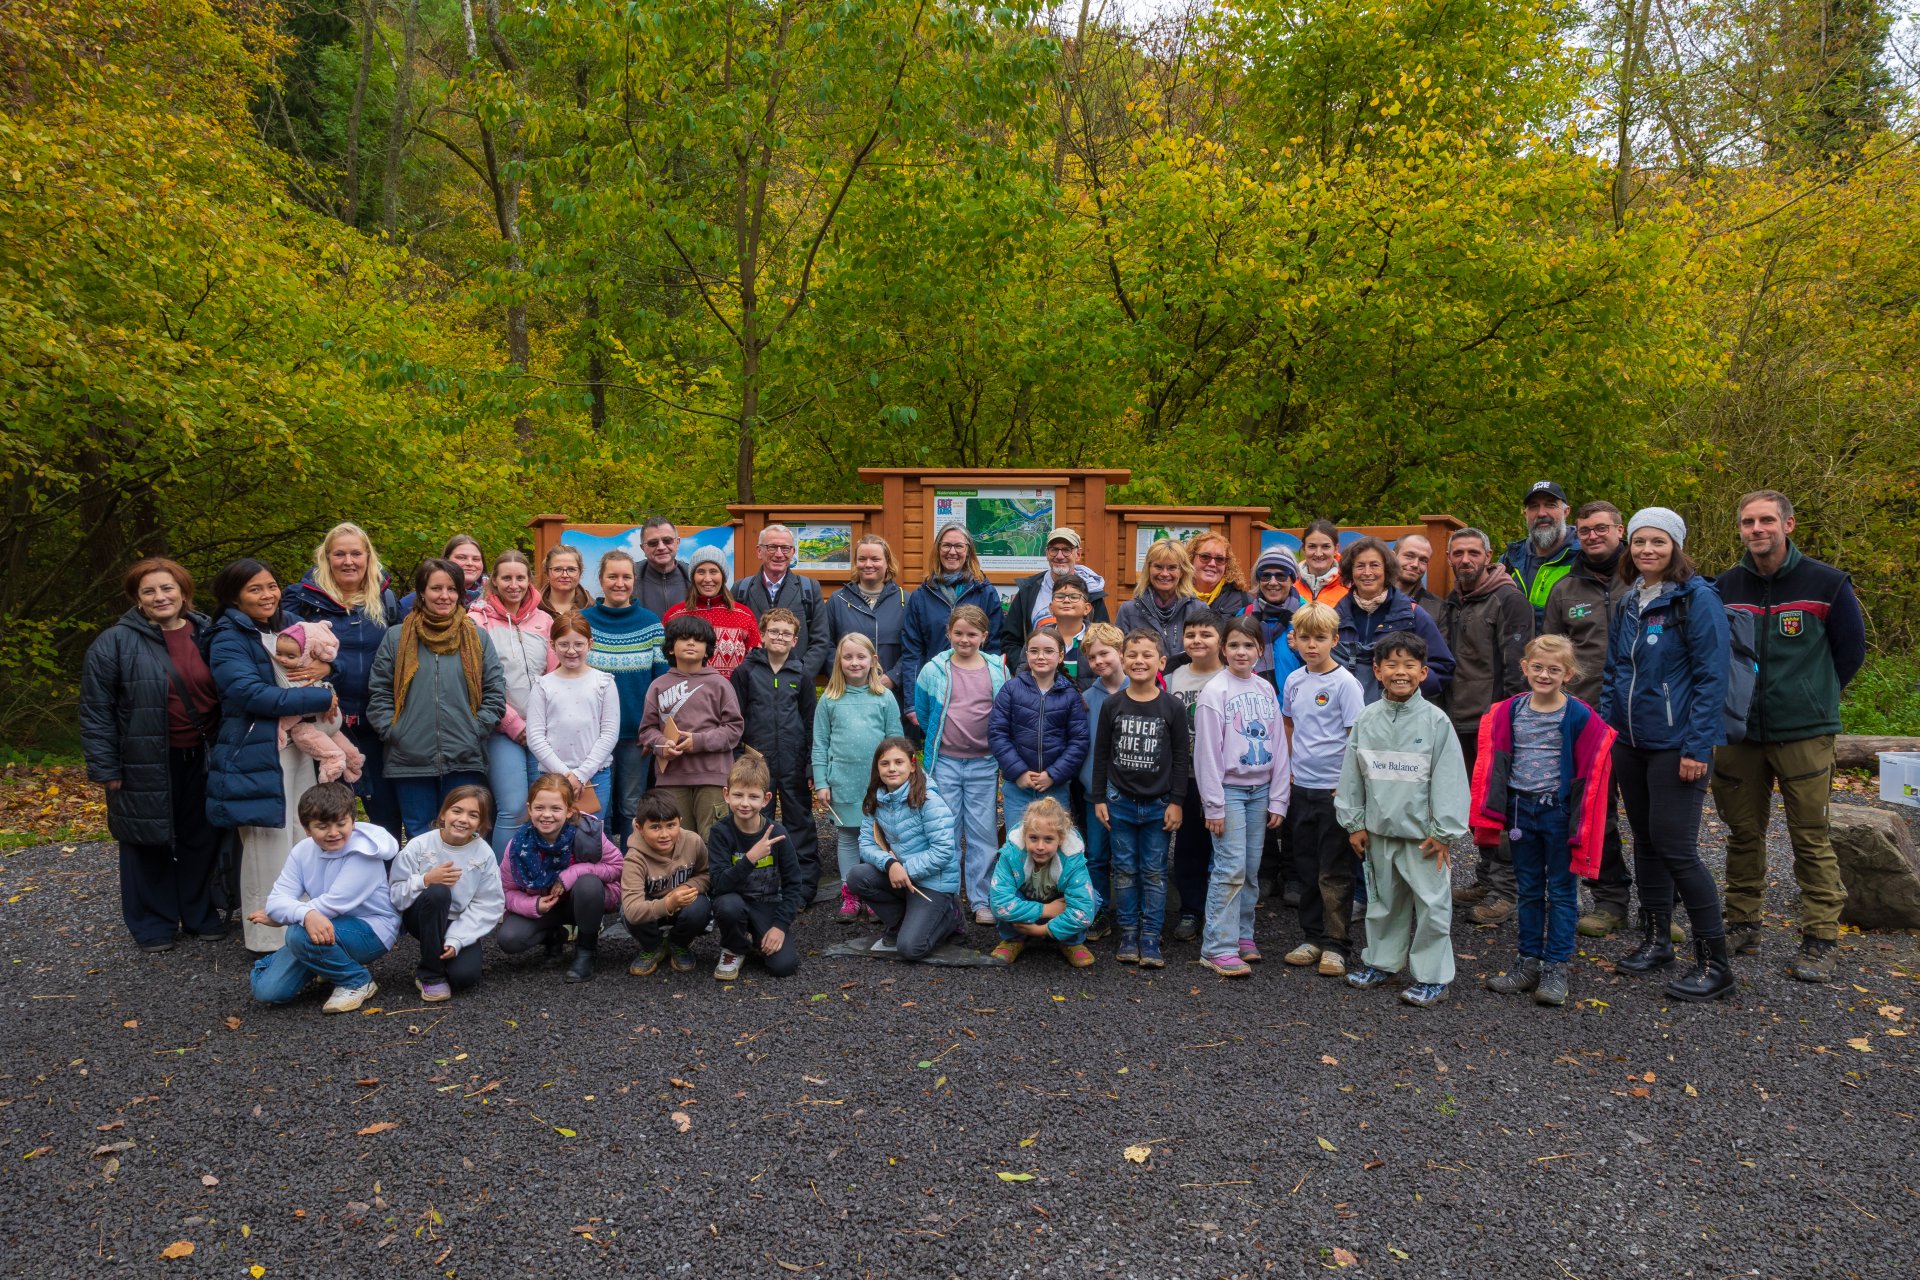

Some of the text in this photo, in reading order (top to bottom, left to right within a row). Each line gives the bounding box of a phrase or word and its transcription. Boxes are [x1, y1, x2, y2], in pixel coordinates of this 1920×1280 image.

[658, 680, 689, 712] NIKE
[1121, 719, 1157, 736] NEVER
[1118, 735, 1158, 753] GIVE UP
[1119, 752, 1154, 762] WORLDWIDE
[1372, 760, 1419, 773] New Balance
[645, 877, 669, 894] NEW
